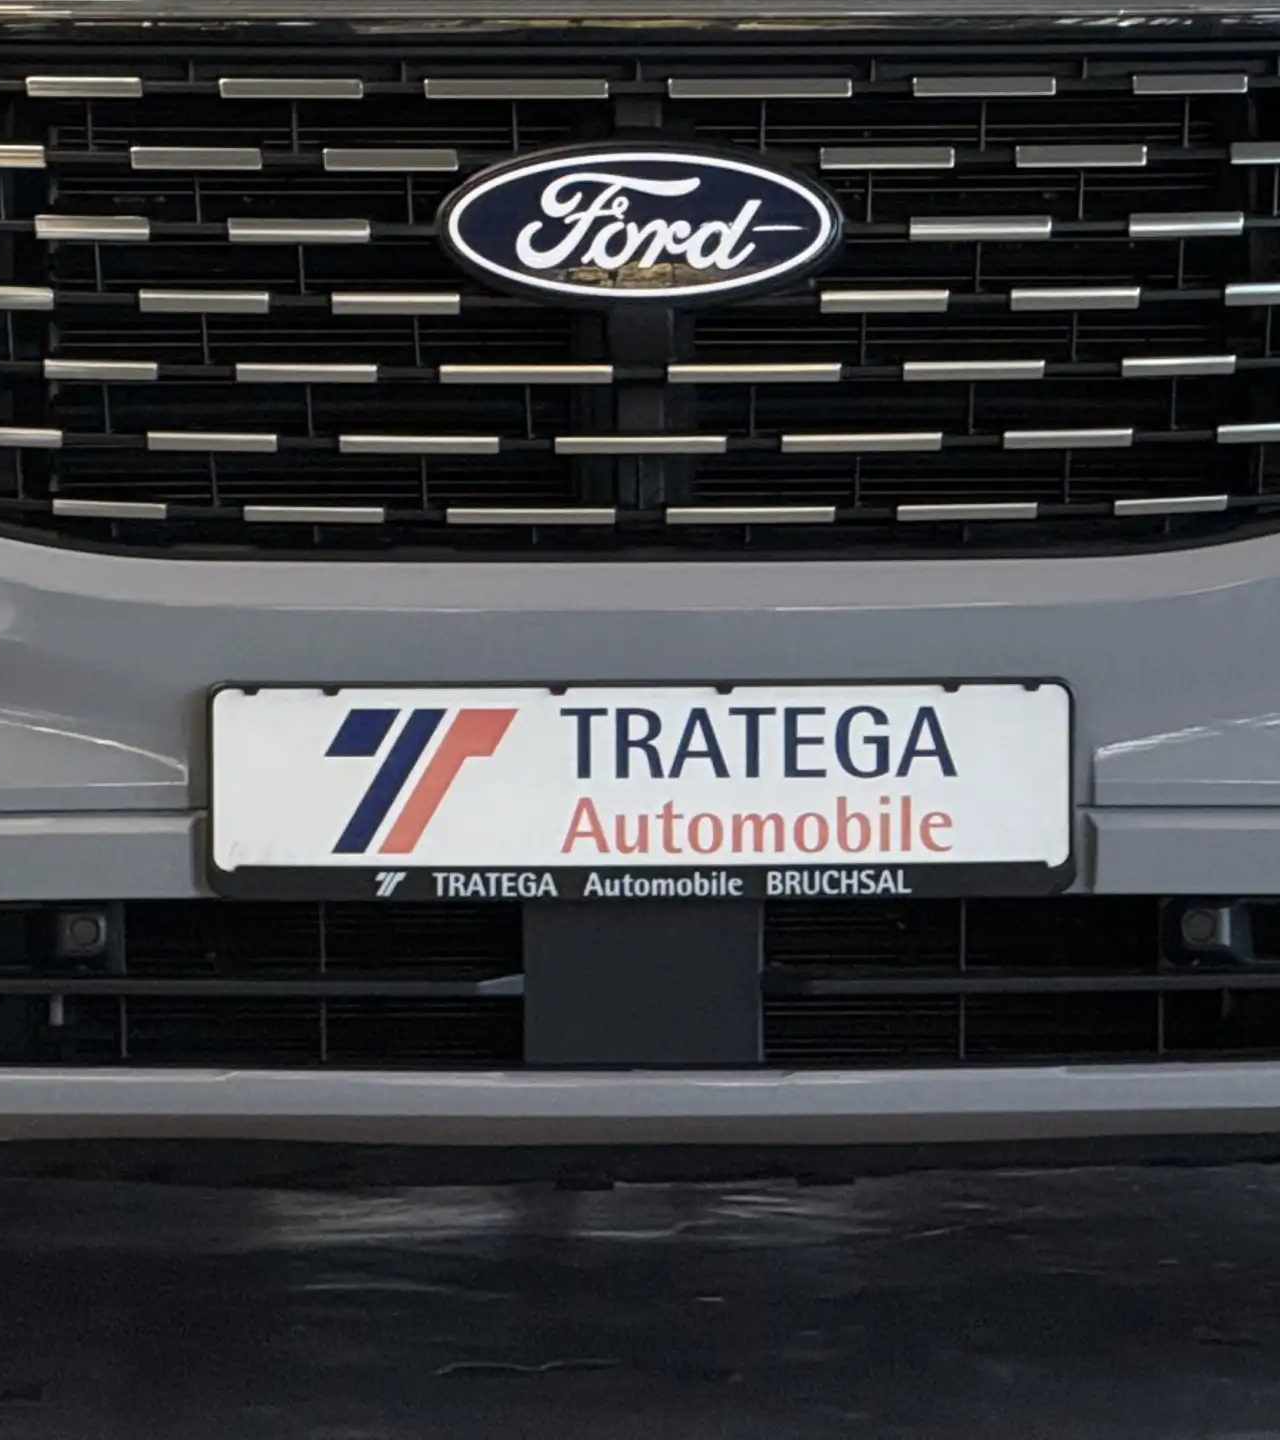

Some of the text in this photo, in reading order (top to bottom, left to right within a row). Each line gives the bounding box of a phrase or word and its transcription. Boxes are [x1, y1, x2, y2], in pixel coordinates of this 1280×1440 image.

[516, 172, 808, 270] Ford
[559, 705, 958, 779] TRATEGA
[561, 796, 953, 854] Automobile
[432, 869, 912, 897] TRATEGA Automobile BRUCHSAL
